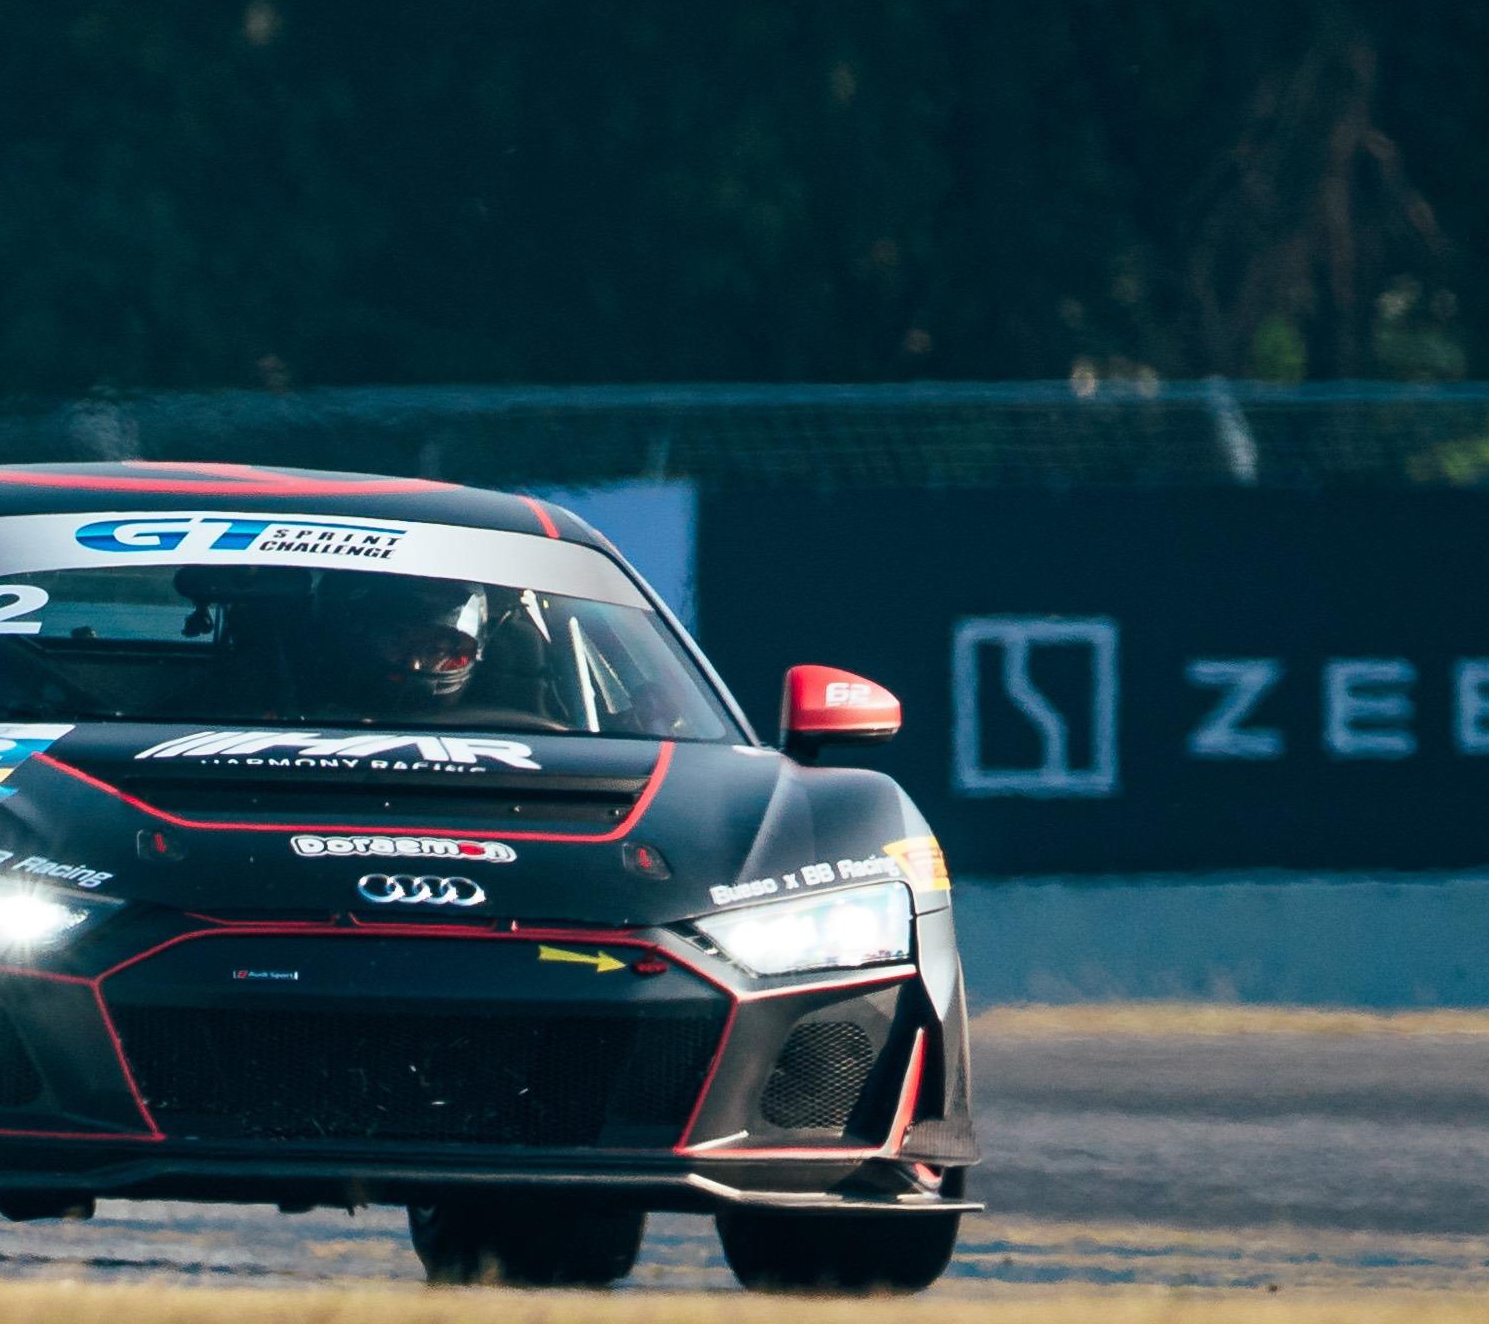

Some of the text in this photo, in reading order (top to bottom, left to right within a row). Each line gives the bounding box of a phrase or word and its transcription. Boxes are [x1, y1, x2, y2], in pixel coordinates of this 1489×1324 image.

[75, 518, 277, 553] GT
[258, 540, 397, 560] CHALLENGE
[273, 528, 403, 547] SPRINT
[825, 682, 872, 704] 62
[291, 834, 518, 863] Doraemon
[11, 855, 115, 889] Racing
[709, 877, 779, 906] Bueso
[782, 872, 800, 890] x
[800, 861, 836, 886] BB
[836, 854, 901, 880] Racing
